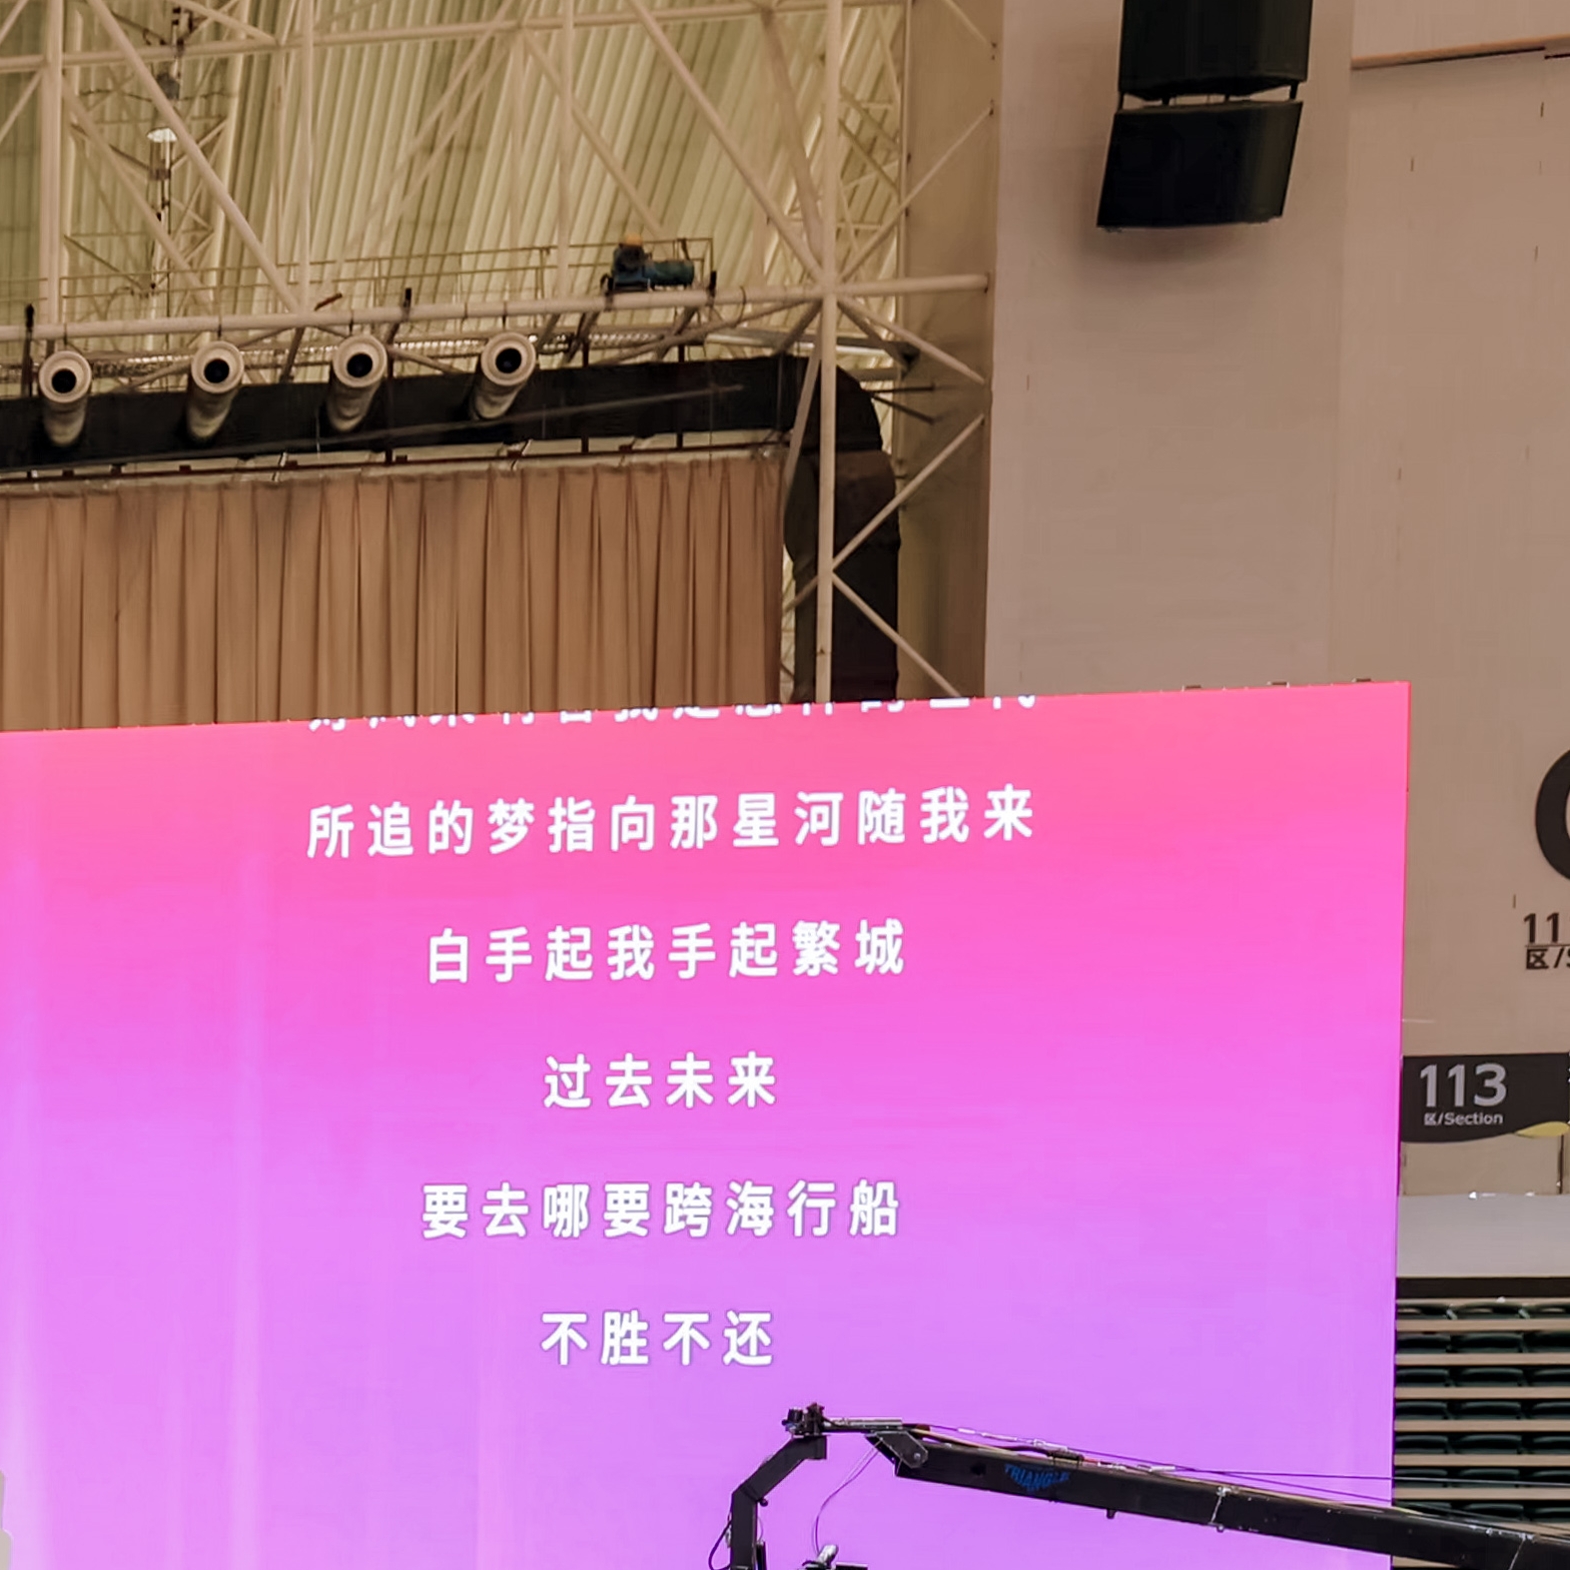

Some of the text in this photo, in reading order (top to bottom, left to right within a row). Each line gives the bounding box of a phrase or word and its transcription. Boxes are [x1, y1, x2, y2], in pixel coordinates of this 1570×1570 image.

[306, 784, 1034, 859] 所追的梦指向那星河随我来
[428, 917, 905, 984] 白手起我手起繁城
[1523, 912, 1570, 944] 11
[543, 1050, 776, 1109] 过去未来
[1420, 1063, 1507, 1107] 113
[421, 1178, 900, 1239] 要去哪要跨海行船
[540, 1309, 773, 1366] 不胜不还
